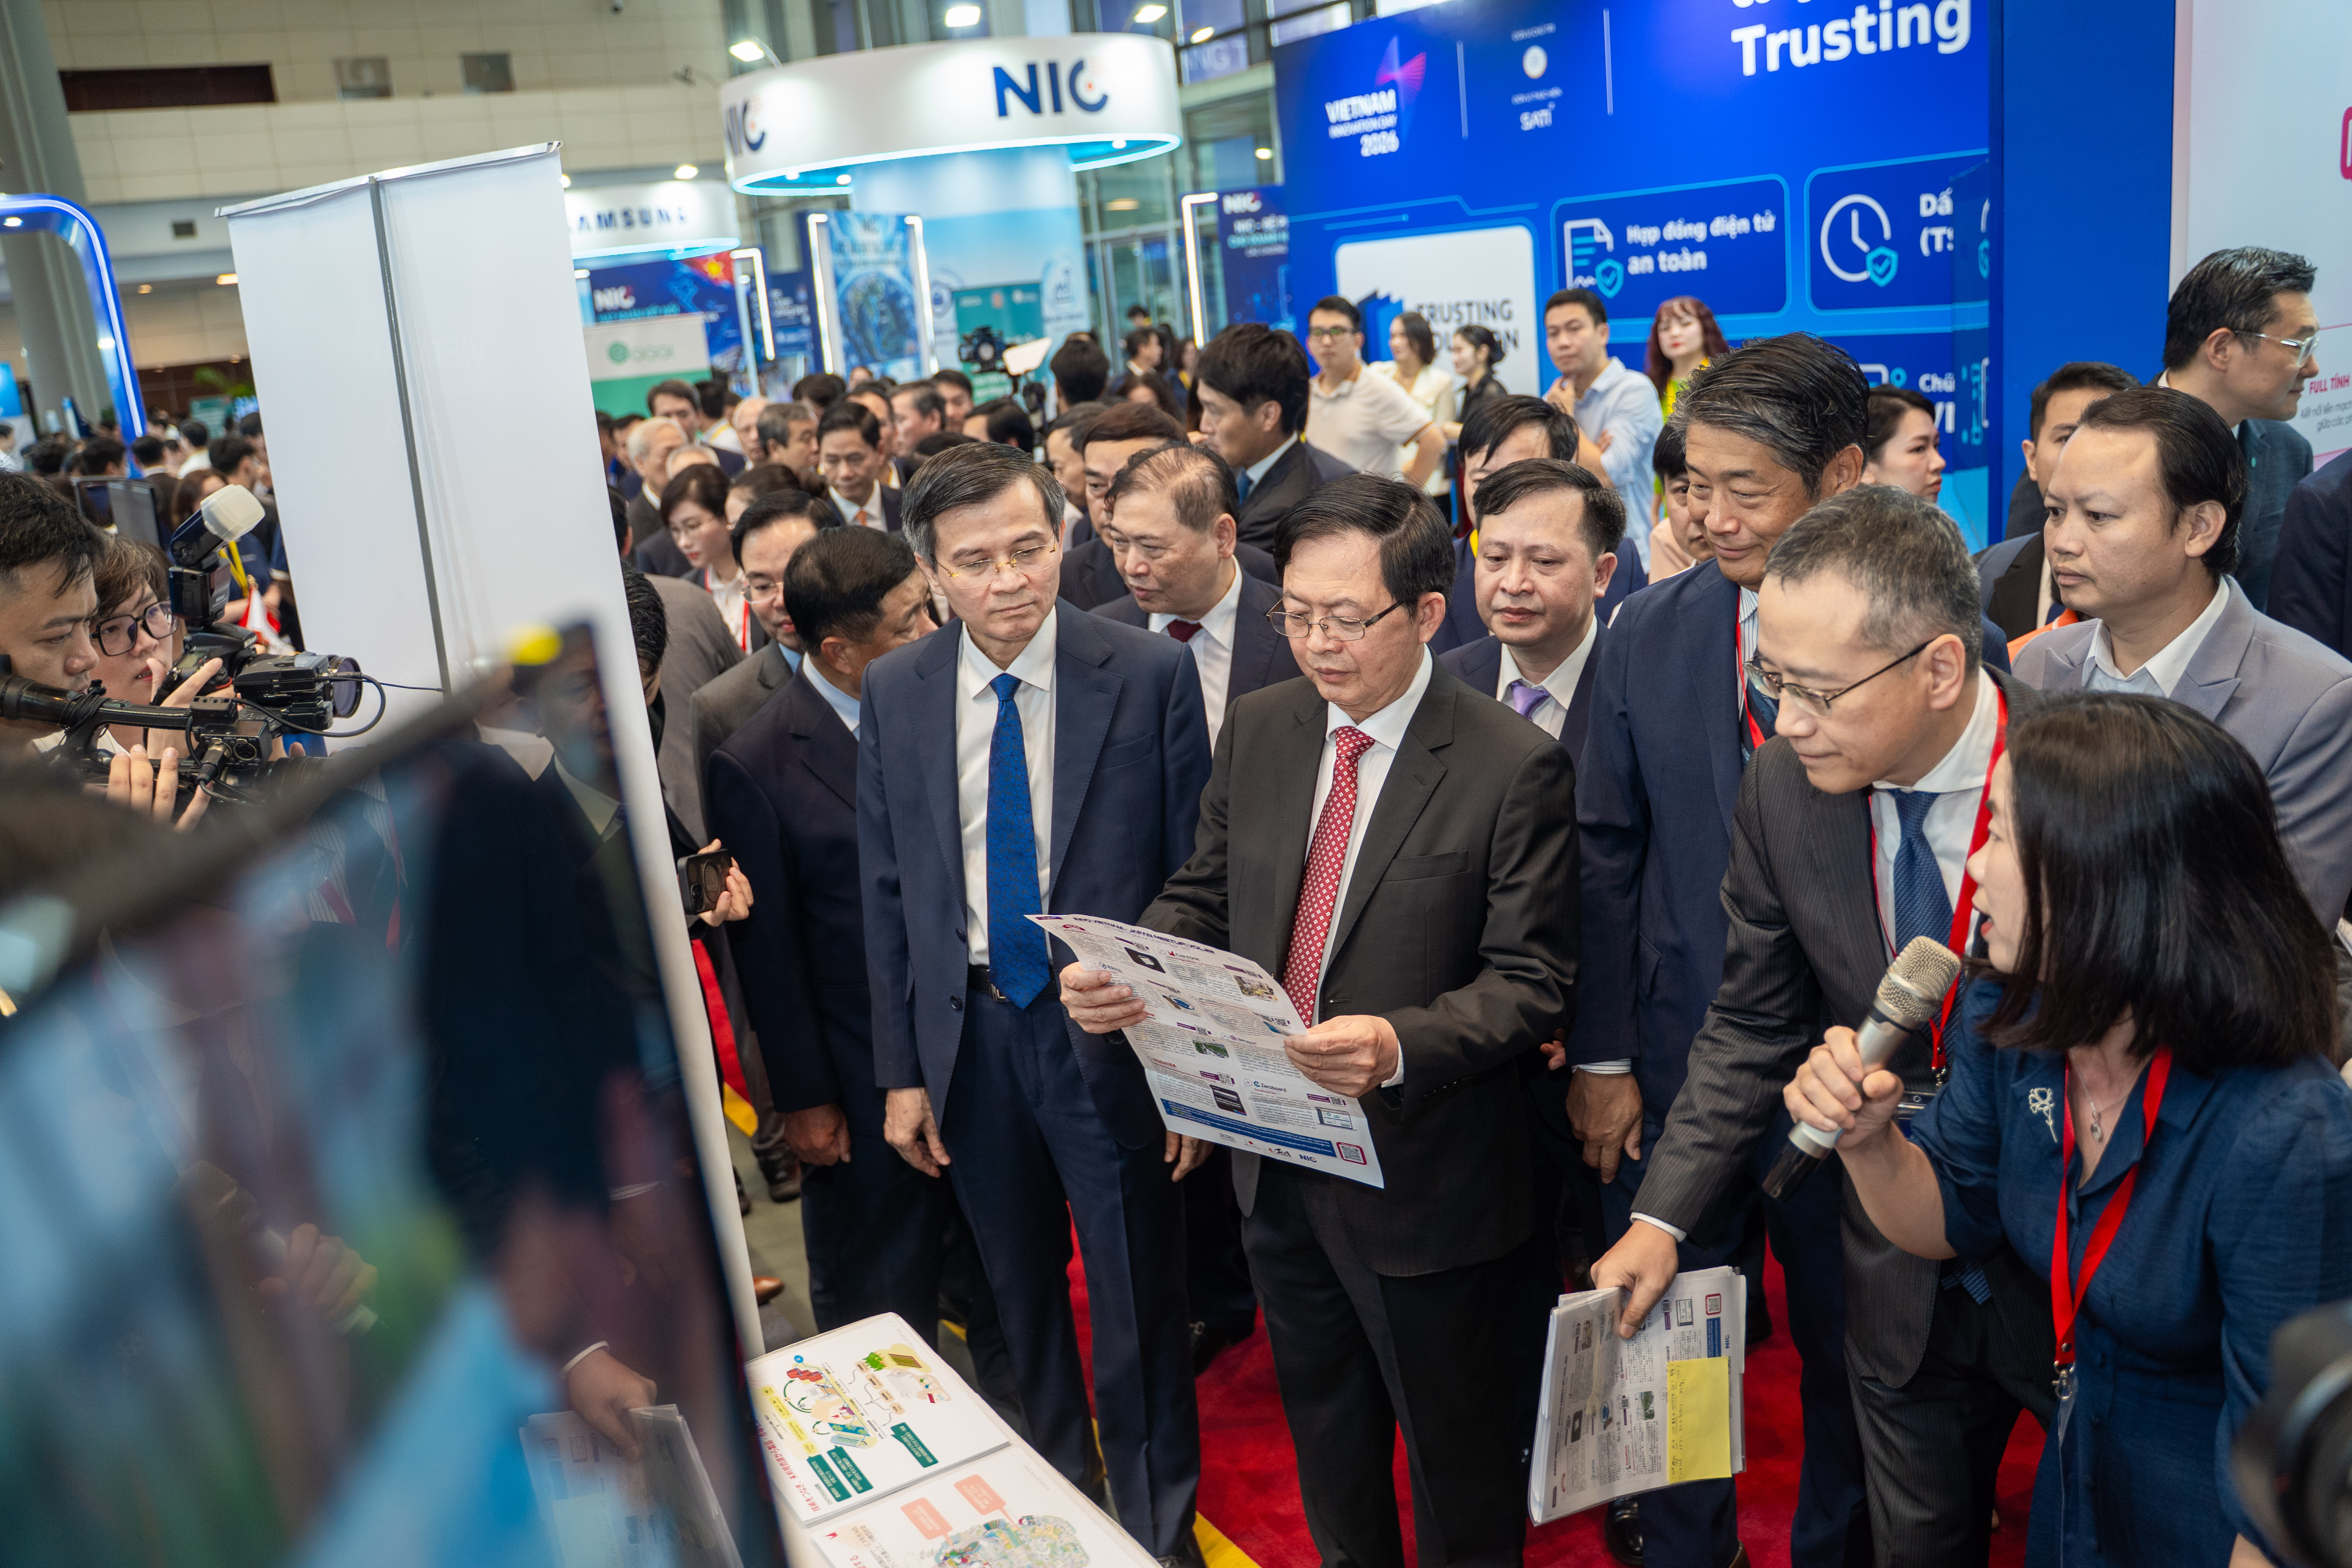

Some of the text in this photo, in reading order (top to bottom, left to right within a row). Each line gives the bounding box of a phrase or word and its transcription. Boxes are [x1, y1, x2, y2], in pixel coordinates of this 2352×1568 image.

[1731, 0, 1972, 76] Trusting
[993, 58, 1109, 118] NIC
[1325, 89, 1396, 123] VIETNAM
[1222, 192, 1262, 214] NIC
[568, 207, 687, 232] AMSUNG
[1626, 209, 1776, 247] Hợp đồng điện tử
[1627, 246, 1708, 275] an toàn
[593, 286, 636, 312] NIC
[1416, 300, 1513, 324] TRUSTING
[2309, 373, 2350, 394] FULL TÍNH
[1092, 920, 1124, 930] VIETNAM
[1129, 929, 1153, 938] JAPAN
[1153, 1058, 1176, 1067] TOSHIBA
[1260, 1083, 1287, 1092] Zeroboard
[1299, 1154, 1317, 1163] NIC
